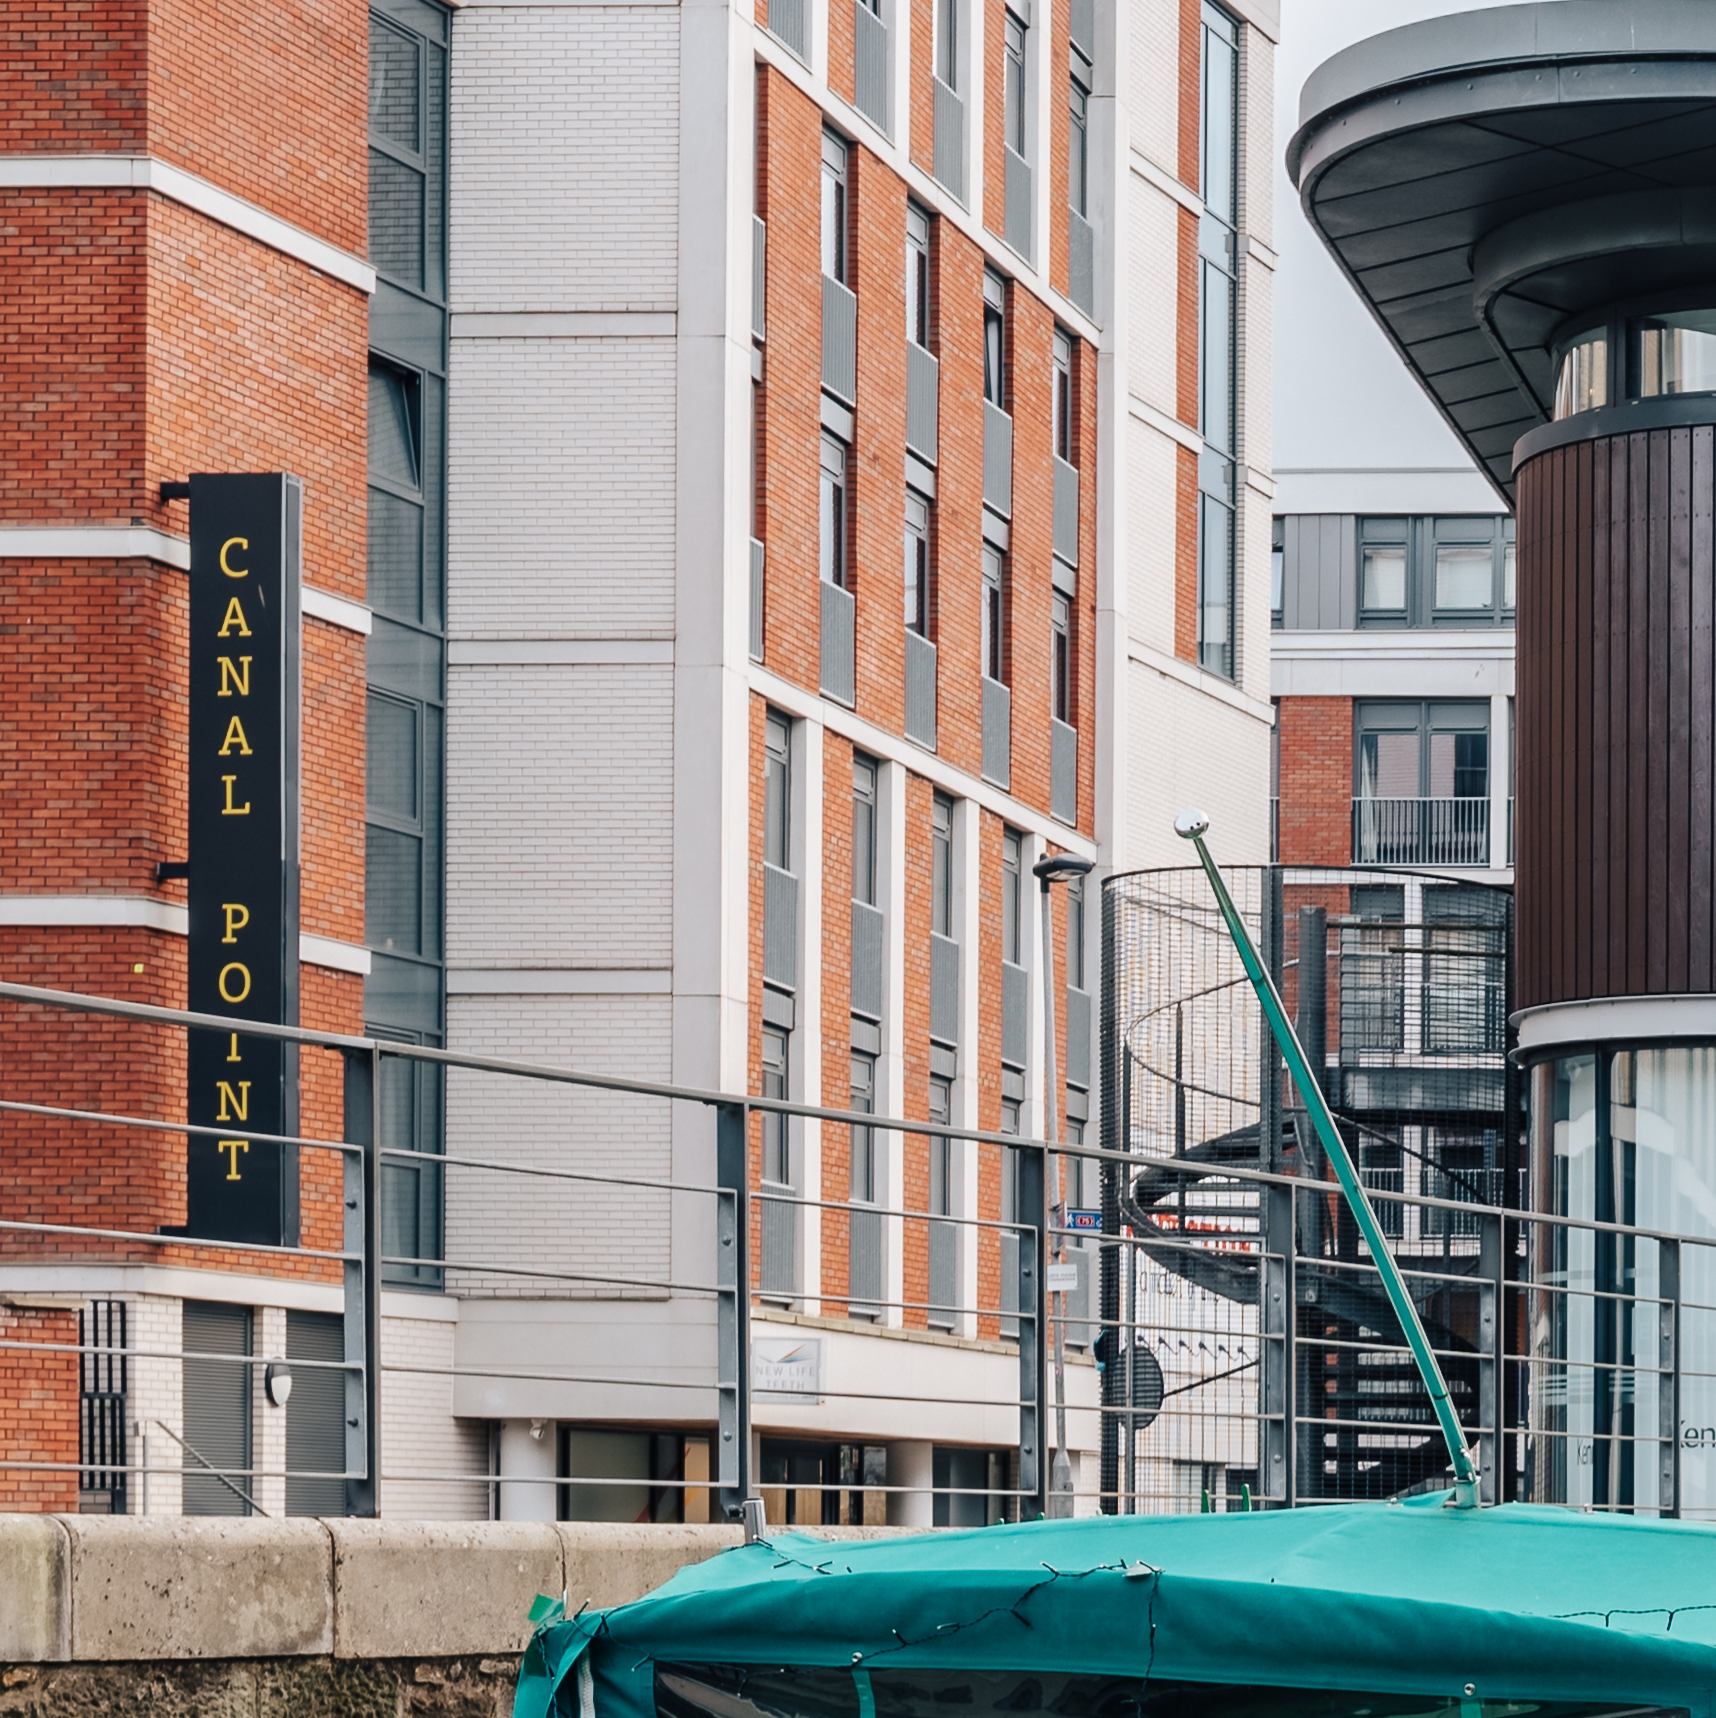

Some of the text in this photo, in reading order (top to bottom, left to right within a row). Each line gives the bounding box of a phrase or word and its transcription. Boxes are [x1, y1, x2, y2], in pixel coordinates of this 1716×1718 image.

[216, 536, 253, 815] CANAL
[216, 902, 252, 1181] POINT
[755, 1365, 816, 1377] NEW LIFE
